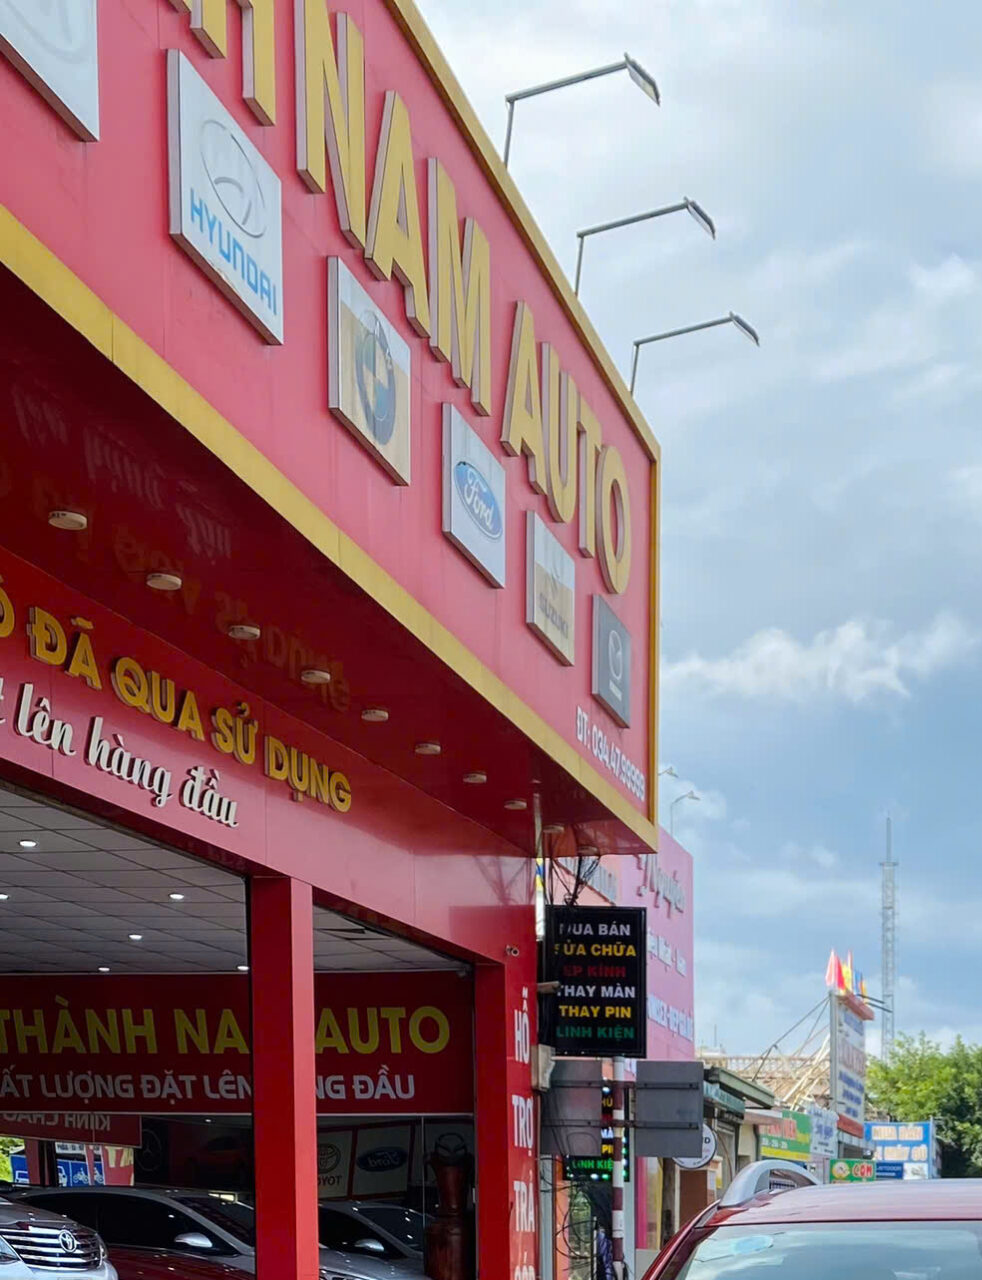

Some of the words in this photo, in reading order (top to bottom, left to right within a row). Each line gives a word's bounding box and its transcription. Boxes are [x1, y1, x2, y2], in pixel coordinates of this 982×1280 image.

[189, 188, 278, 316] HYUNDAI
[296, 0, 491, 417] NAM
[500, 300, 631, 594] AUTO
[539, 593, 569, 639] SUZUKI
[27, 606, 102, 690] ĐÃ
[111, 657, 205, 742] QUA
[211, 702, 259, 765] SỬ
[264, 736, 352, 812] DỤNG
[16, 683, 77, 756] lên
[87, 716, 174, 807] hàng
[181, 766, 240, 828] đầu
[590, 941, 637, 957] CHỮA
[598, 920, 631, 936] BÁN
[559, 1005, 600, 1018] THAY
[605, 1006, 632, 1019] PIN
[601, 983, 636, 998] MÀN
[0, 995, 158, 1054] THÀNH
[315, 1006, 450, 1054] AUTO
[514, 986, 530, 1064] HỖ
[556, 1026, 593, 1039] LINH
[39, 1070, 135, 1104] LƯỢNG
[140, 1069, 197, 1105] ĐẶT
[352, 1064, 415, 1099] ĐẦU
[512, 1094, 534, 1156] TRỢ
[513, 1171, 535, 1233] TRẢ
